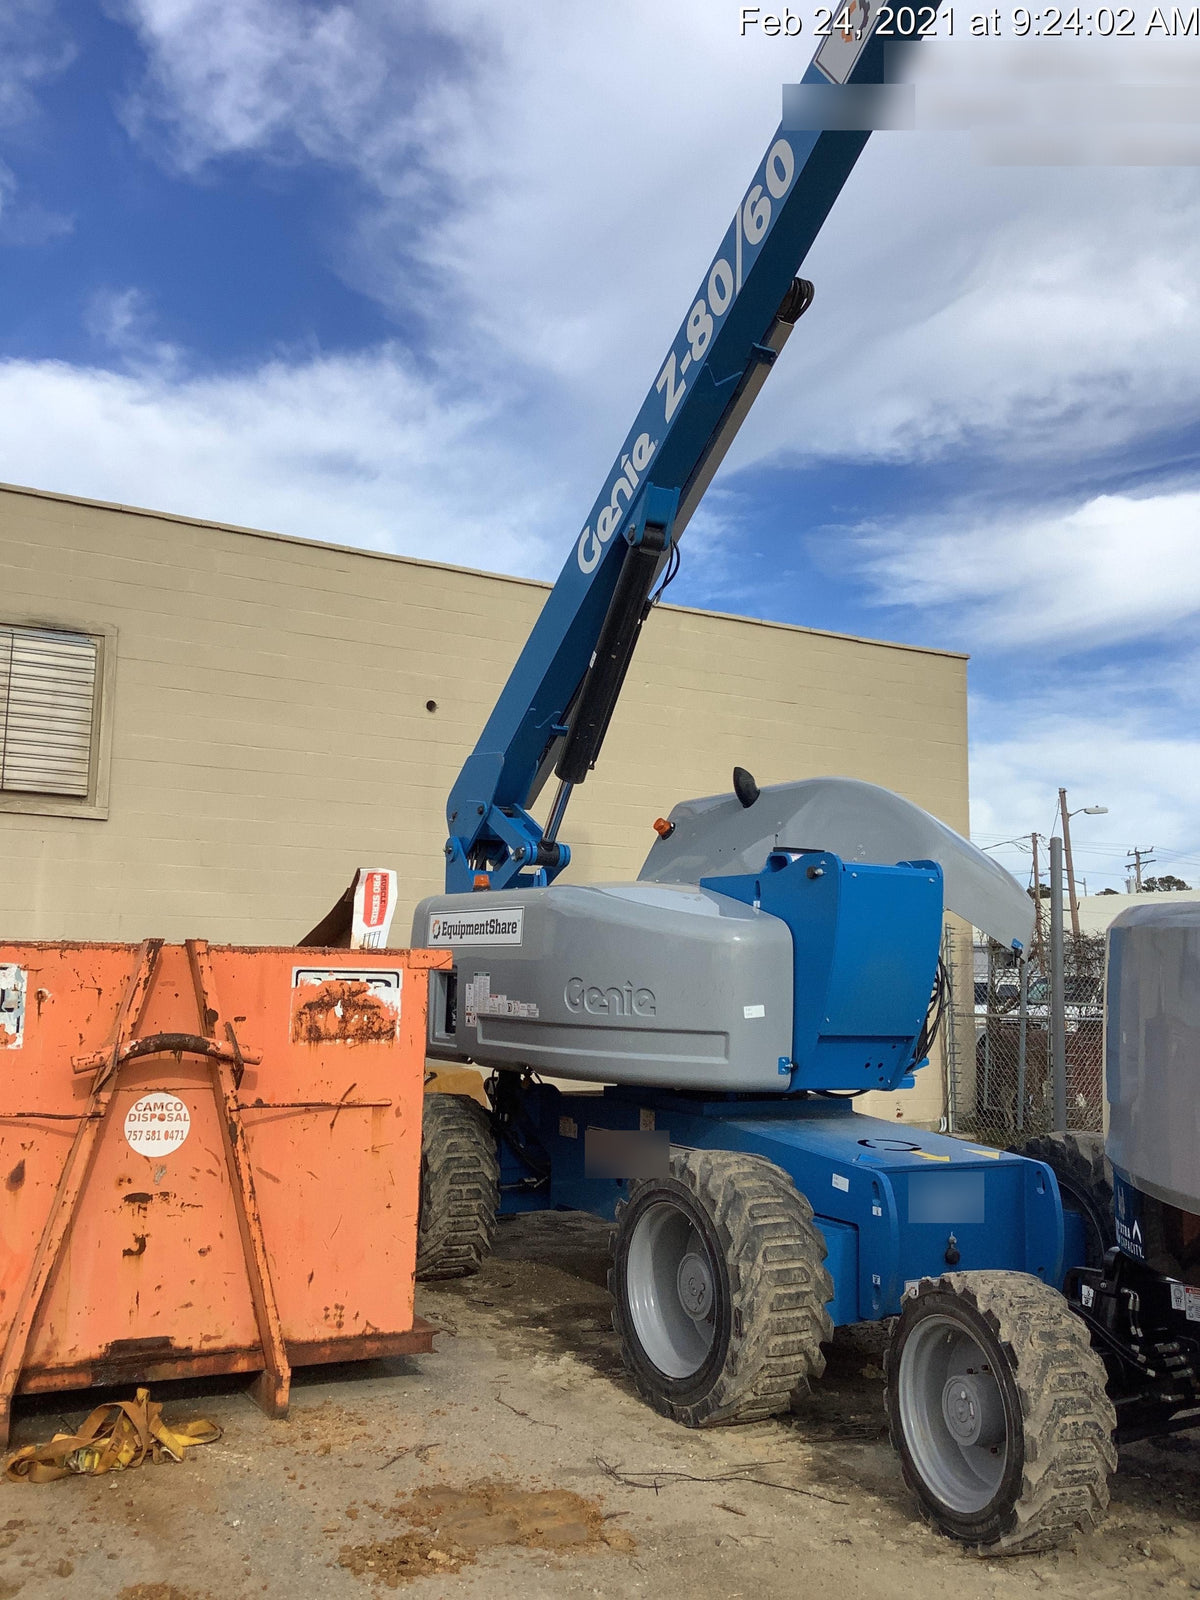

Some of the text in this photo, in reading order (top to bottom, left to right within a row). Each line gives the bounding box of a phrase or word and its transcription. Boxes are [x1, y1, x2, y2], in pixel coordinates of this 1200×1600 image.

[577, 138, 795, 574] Genie Z-80/60
[370, 874, 381, 925] PRO SERIES
[441, 918, 518, 939] EquipmentShare
[563, 976, 656, 1017] Genie
[128, 1112, 190, 1123] DISPOSAL
[134, 1101, 184, 1113] CAMCO
[127, 1129, 185, 1141] 757 581 0471
